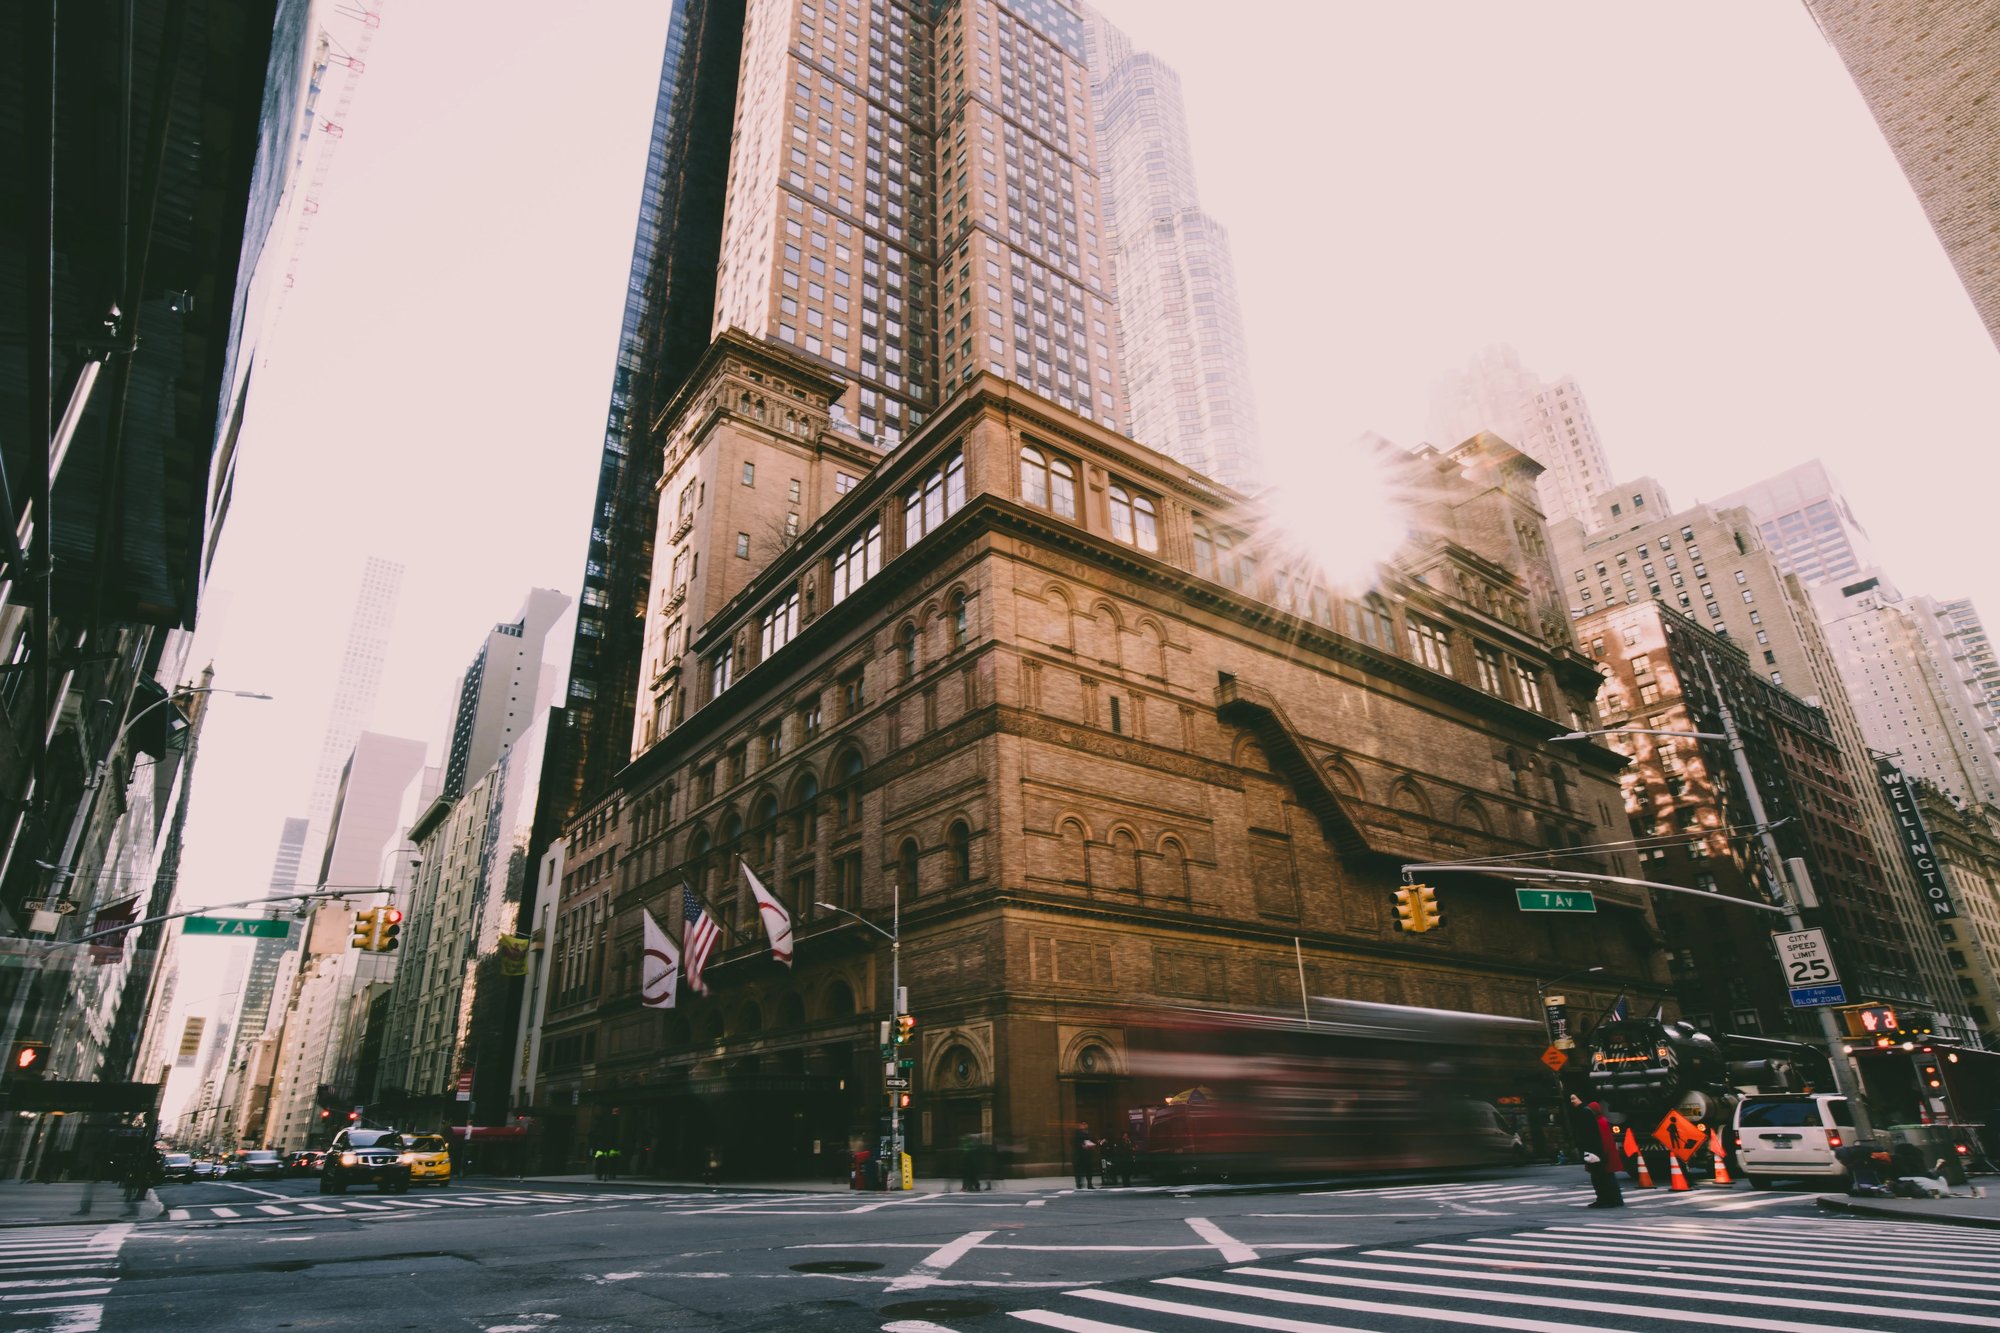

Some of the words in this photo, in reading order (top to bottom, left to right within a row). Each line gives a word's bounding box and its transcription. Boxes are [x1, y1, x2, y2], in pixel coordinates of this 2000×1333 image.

[1882, 772, 1950, 914] WELLINGTON
[1541, 894, 1550, 906] 7
[1556, 895, 1573, 907] Av
[216, 921, 227, 932] 7
[232, 922, 258, 934] Av
[1789, 934, 1808, 942] CITY
[1787, 942, 1816, 951] SPEED
[1792, 950, 1816, 959] LIMIT
[1789, 959, 1830, 982] 25
[1820, 995, 1843, 1003] ZONE
